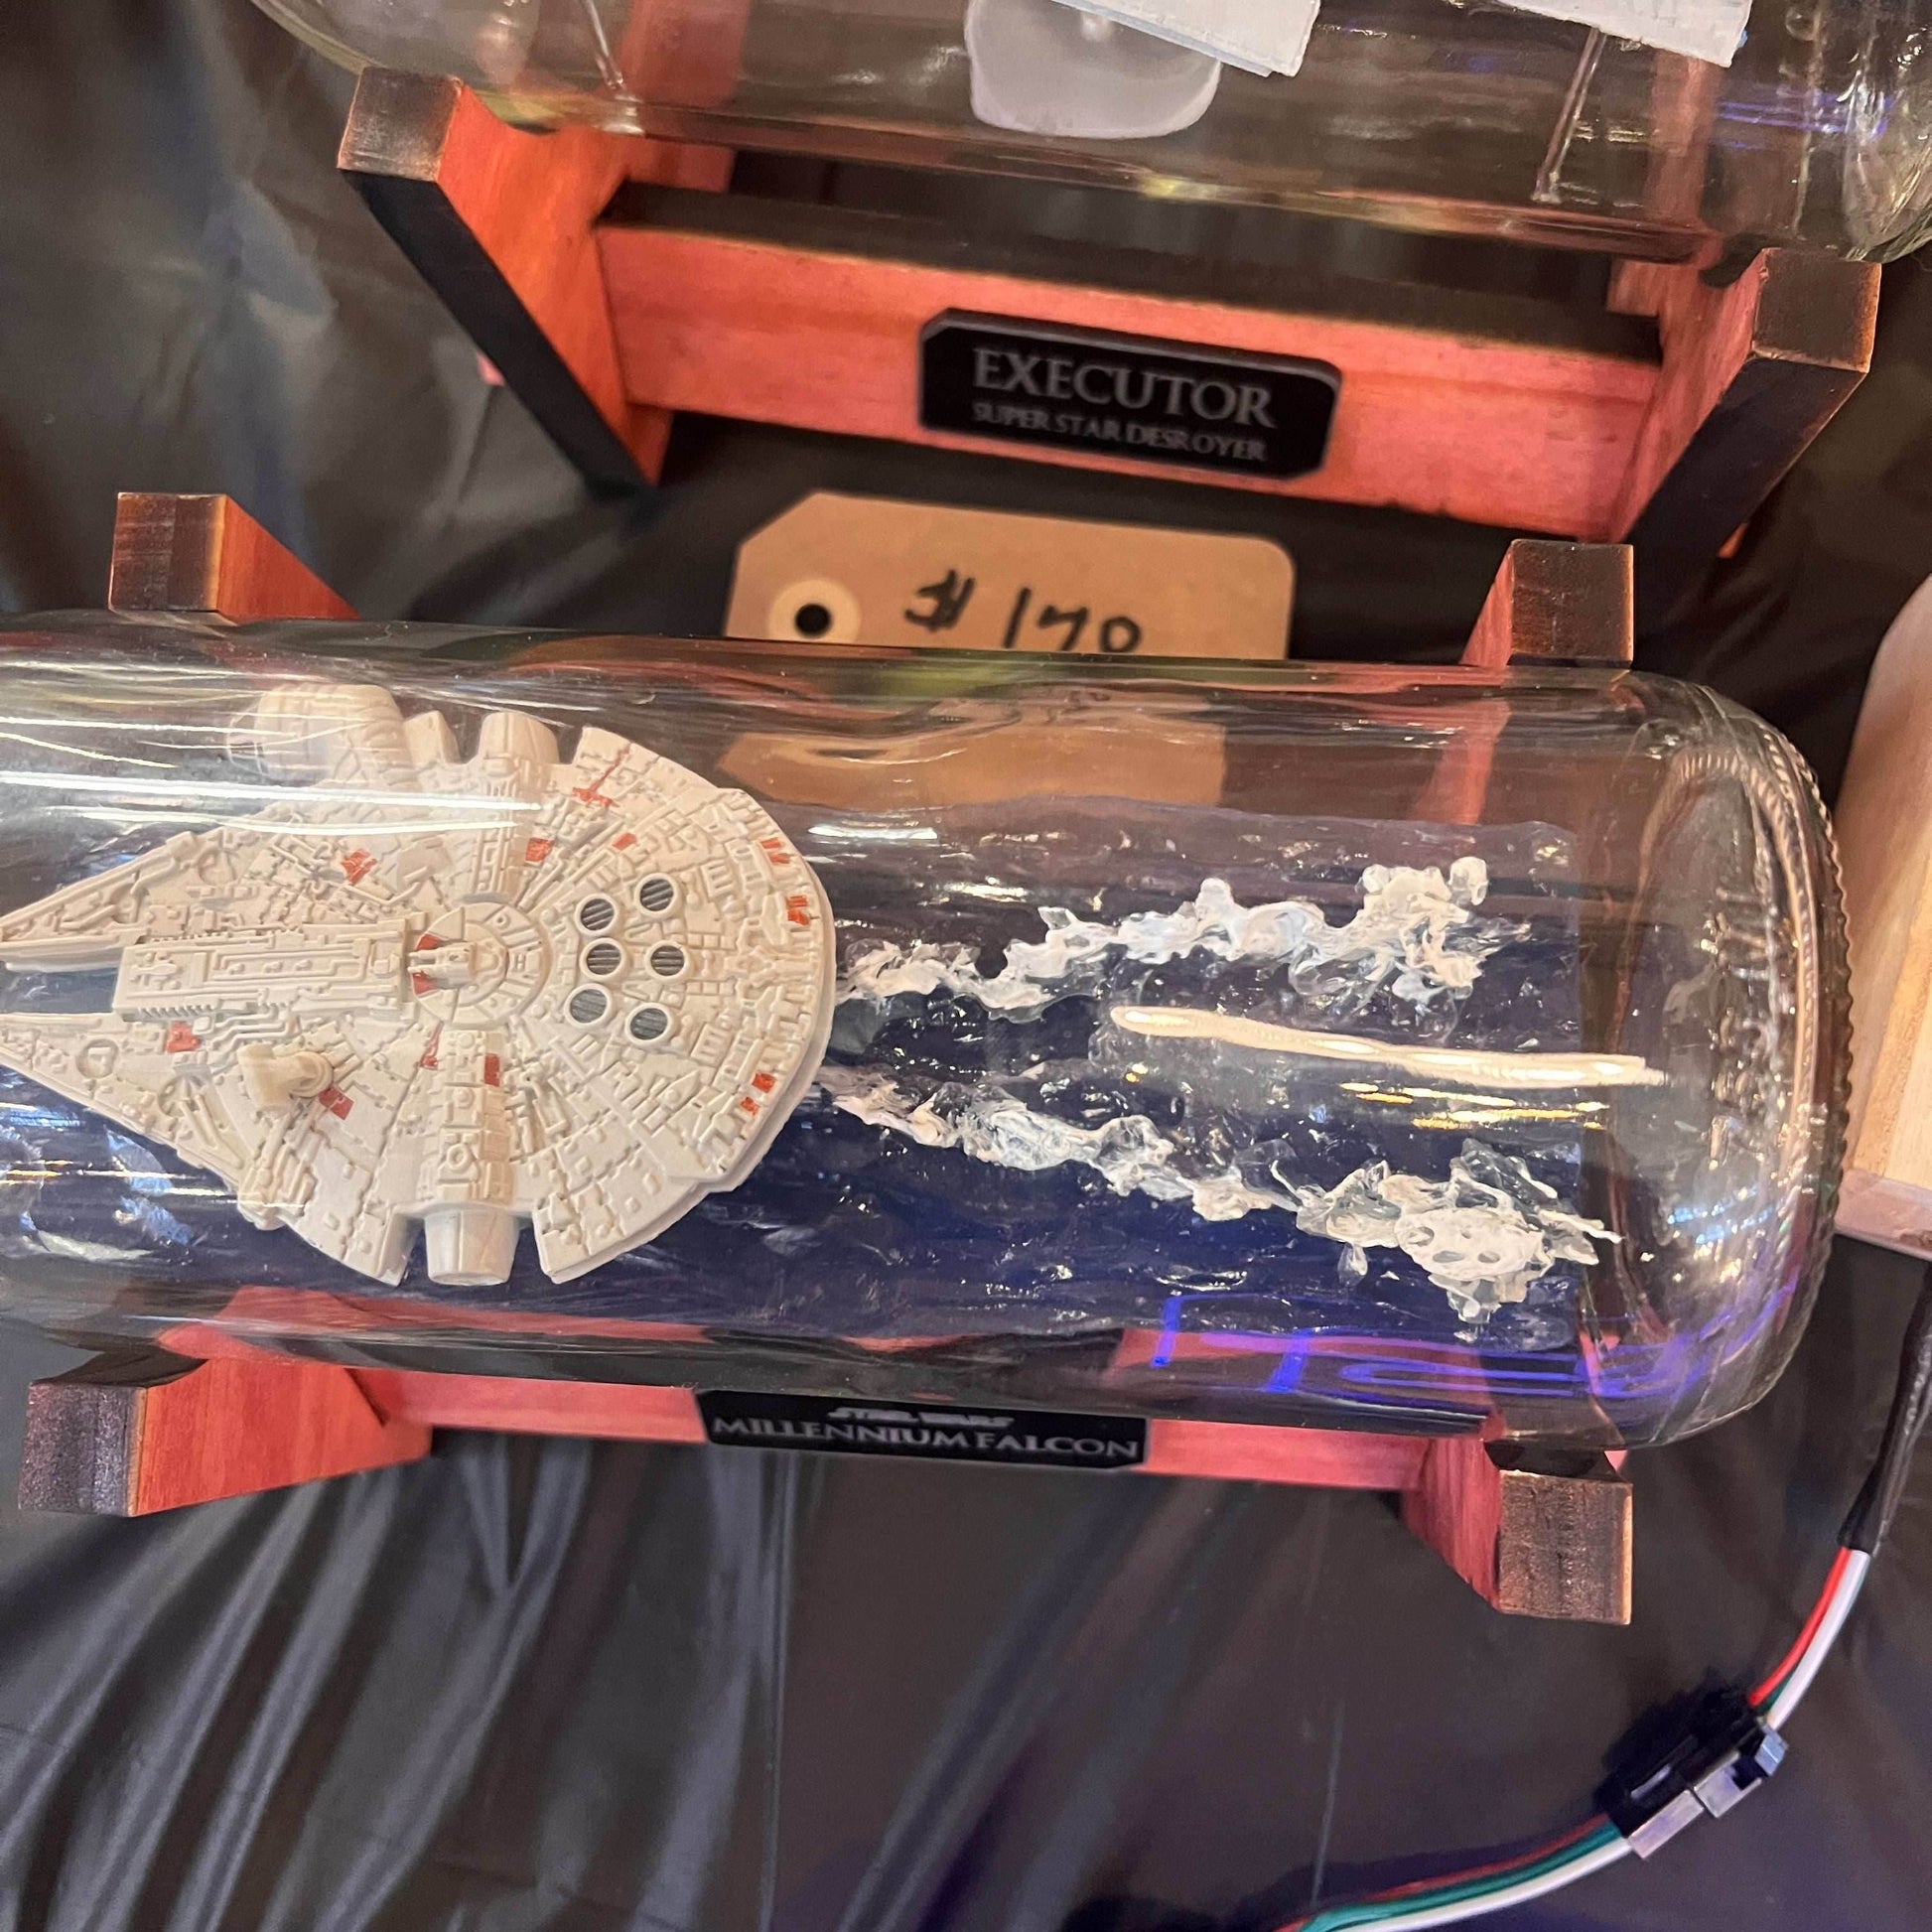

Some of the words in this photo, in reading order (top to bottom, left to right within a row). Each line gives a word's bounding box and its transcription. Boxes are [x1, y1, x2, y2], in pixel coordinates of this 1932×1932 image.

[972, 346, 1278, 429] EXECUTOR
[972, 401, 1050, 431] SUPER
[1054, 412, 1121, 442] STAR
[712, 1416, 972, 1449] MILLENNIUM
[975, 1430, 1141, 1459] FALCON
